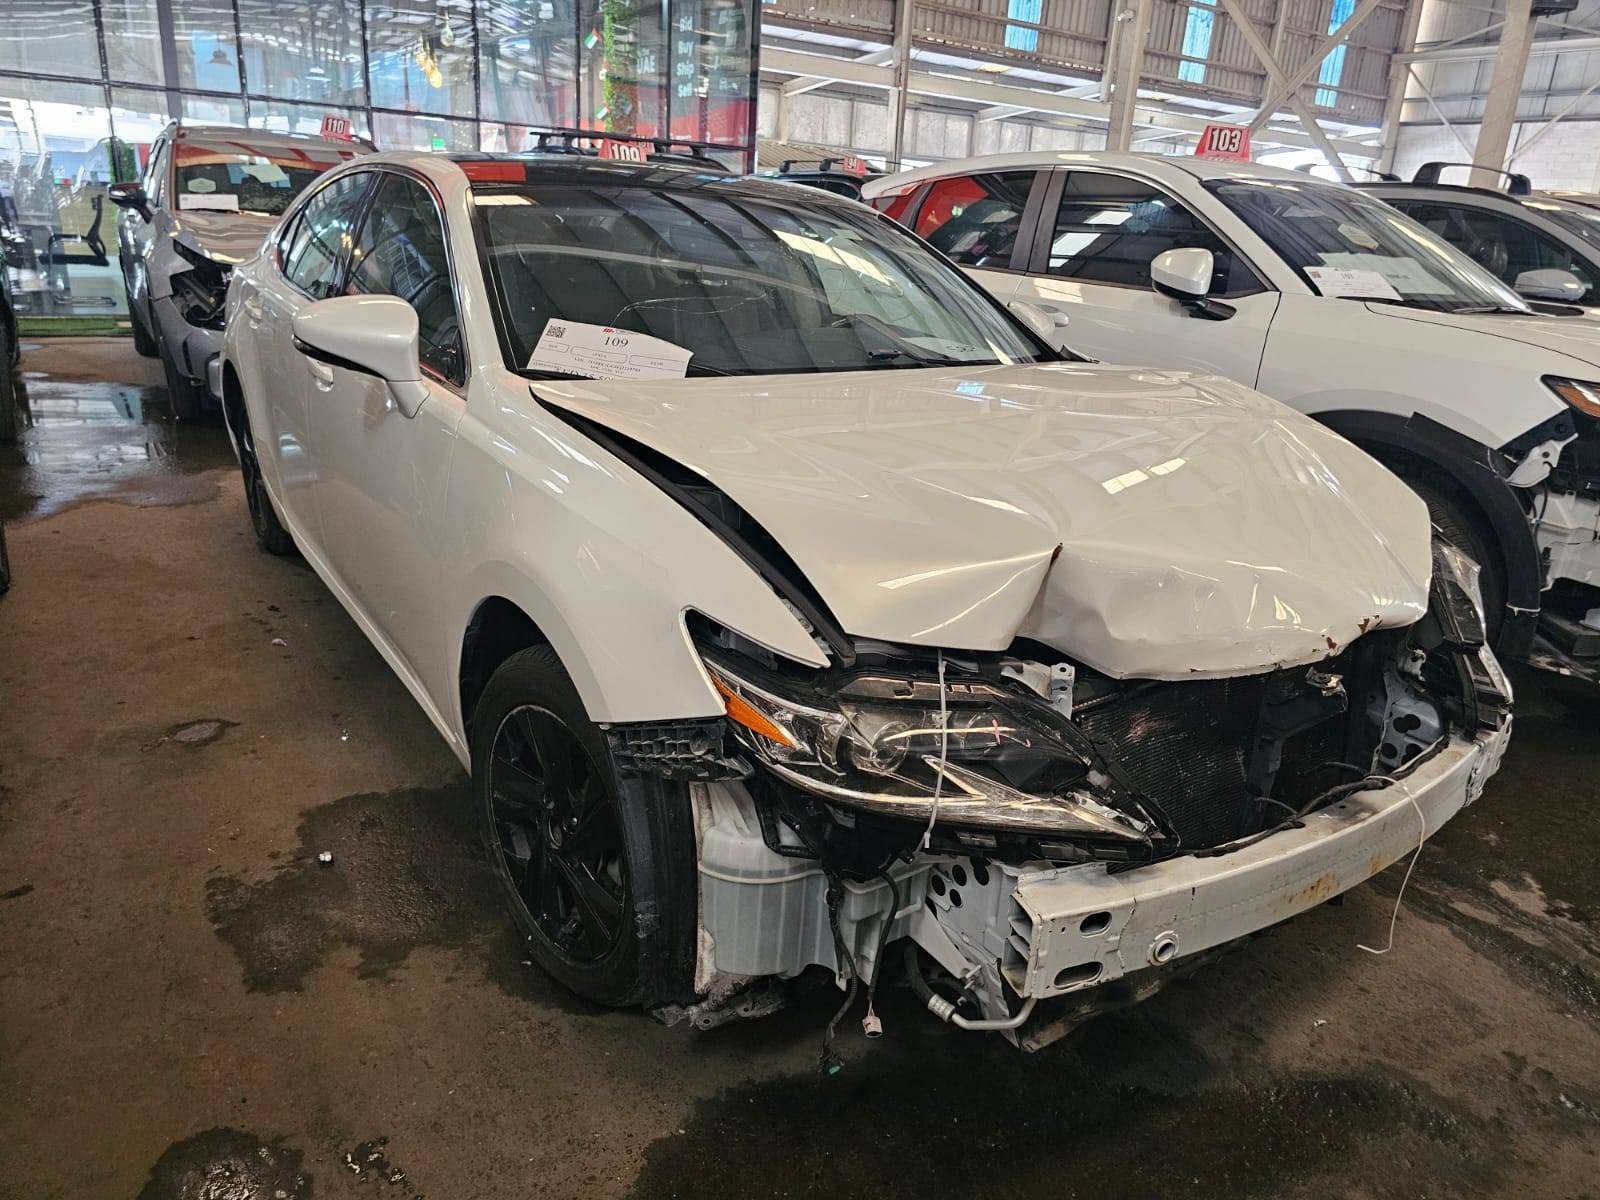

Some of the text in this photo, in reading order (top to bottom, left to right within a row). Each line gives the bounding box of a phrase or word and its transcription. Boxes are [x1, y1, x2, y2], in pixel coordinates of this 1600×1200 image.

[679, 15, 693, 32] Bid
[678, 41, 694, 57] Buy
[636, 55, 656, 75] UAE
[676, 60, 695, 79] Ship
[677, 82, 693, 98] Sell
[327, 118, 345, 134] 110
[1211, 128, 1242, 152] 103
[604, 336, 629, 348] 109
